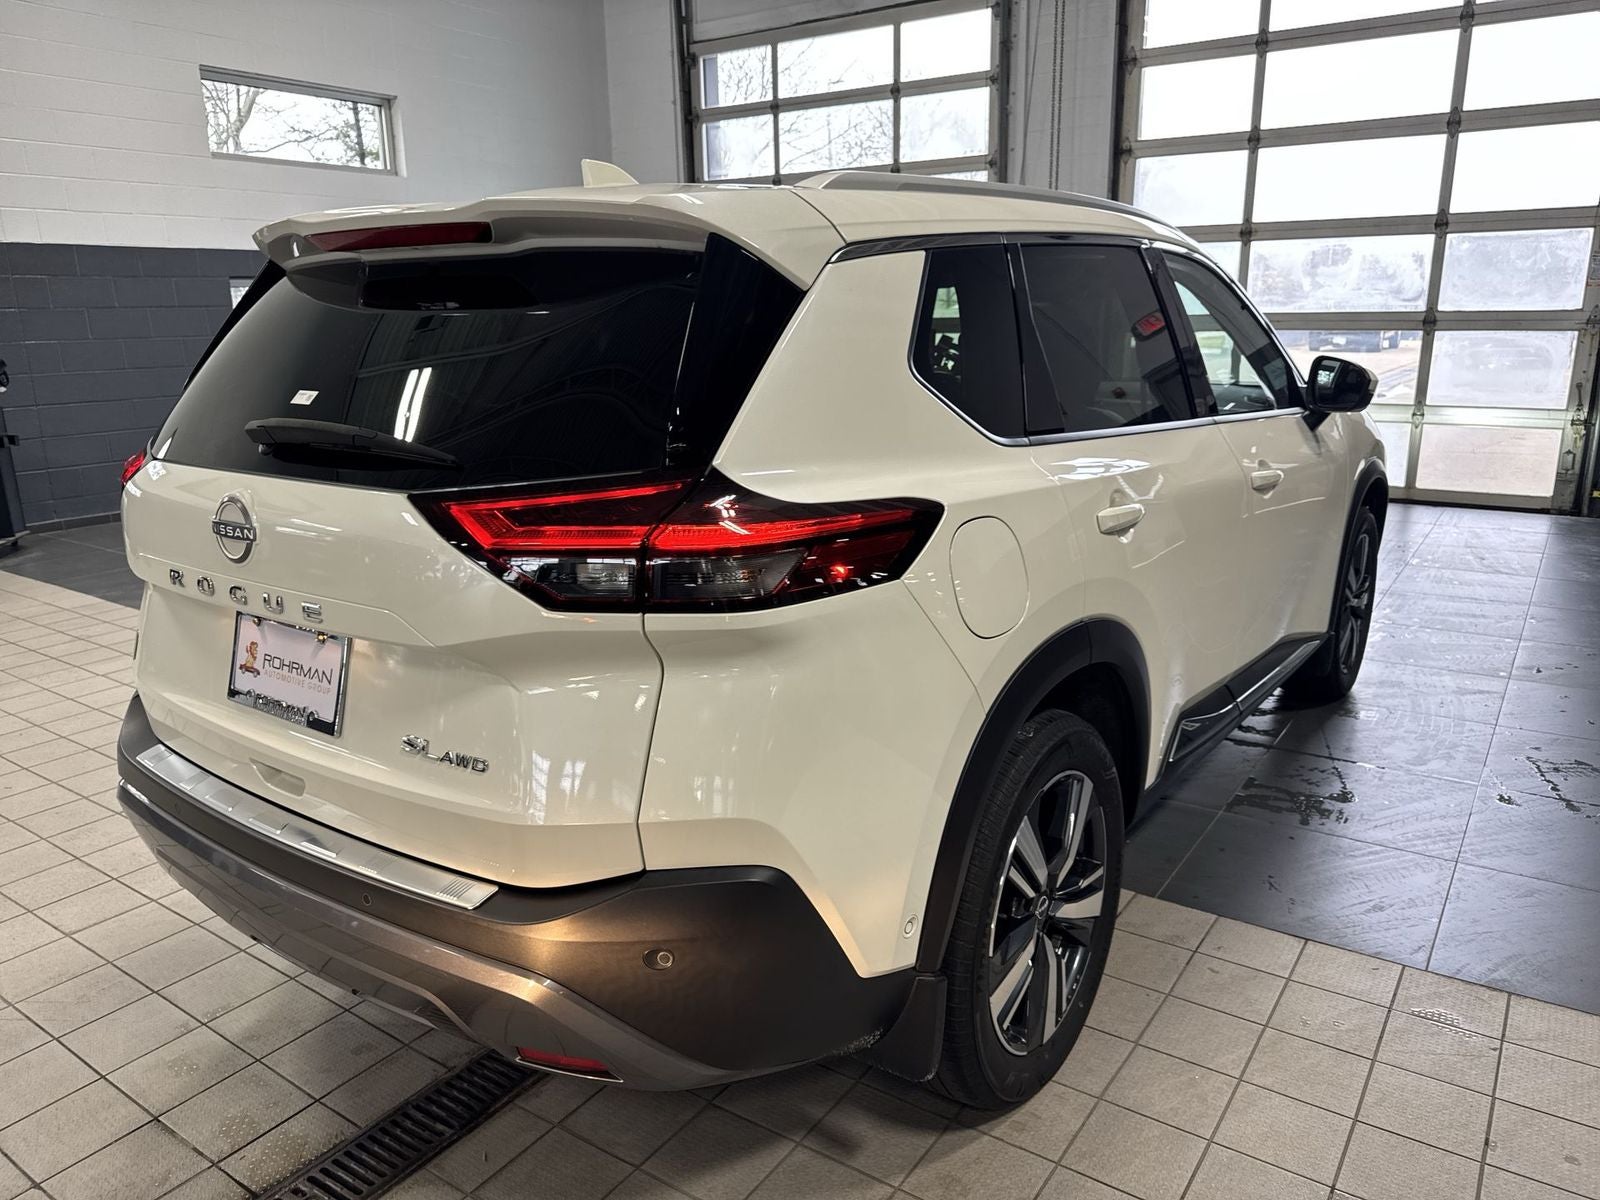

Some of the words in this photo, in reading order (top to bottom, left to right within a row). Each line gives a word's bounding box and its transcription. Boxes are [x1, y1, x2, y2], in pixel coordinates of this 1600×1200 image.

[169, 568, 323, 623] ROGUE
[262, 653, 333, 685] ROHRMAN
[264, 669, 305, 688] AUTOMOTIVE
[307, 681, 332, 696] GROUP
[400, 734, 440, 761] SL
[439, 749, 489, 774] AWD
